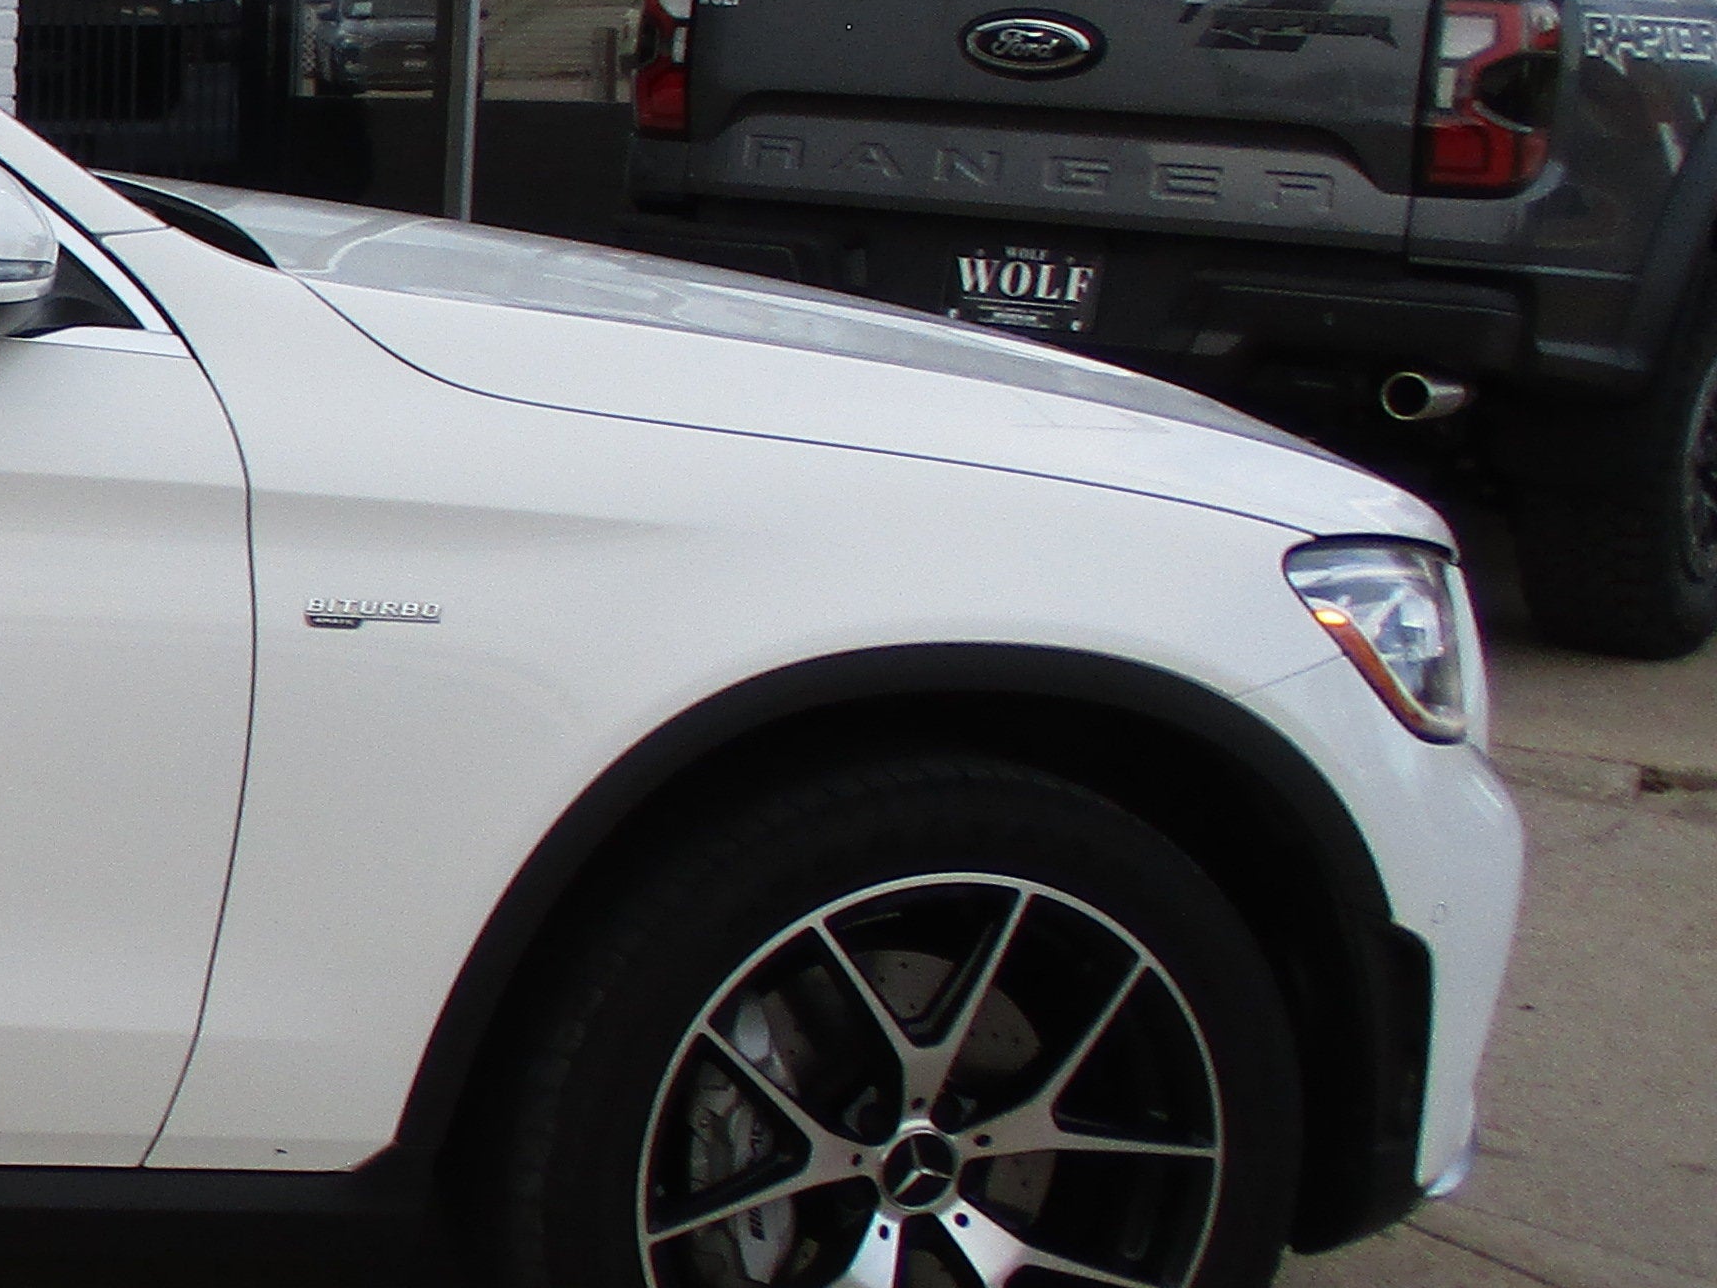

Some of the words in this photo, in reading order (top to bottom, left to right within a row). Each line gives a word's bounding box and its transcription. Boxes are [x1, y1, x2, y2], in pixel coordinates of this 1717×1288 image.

[990, 28, 1061, 58] Ford
[741, 133, 1336, 212] RANGER
[956, 255, 1095, 303] WOLF
[305, 597, 441, 618] BITURBO
